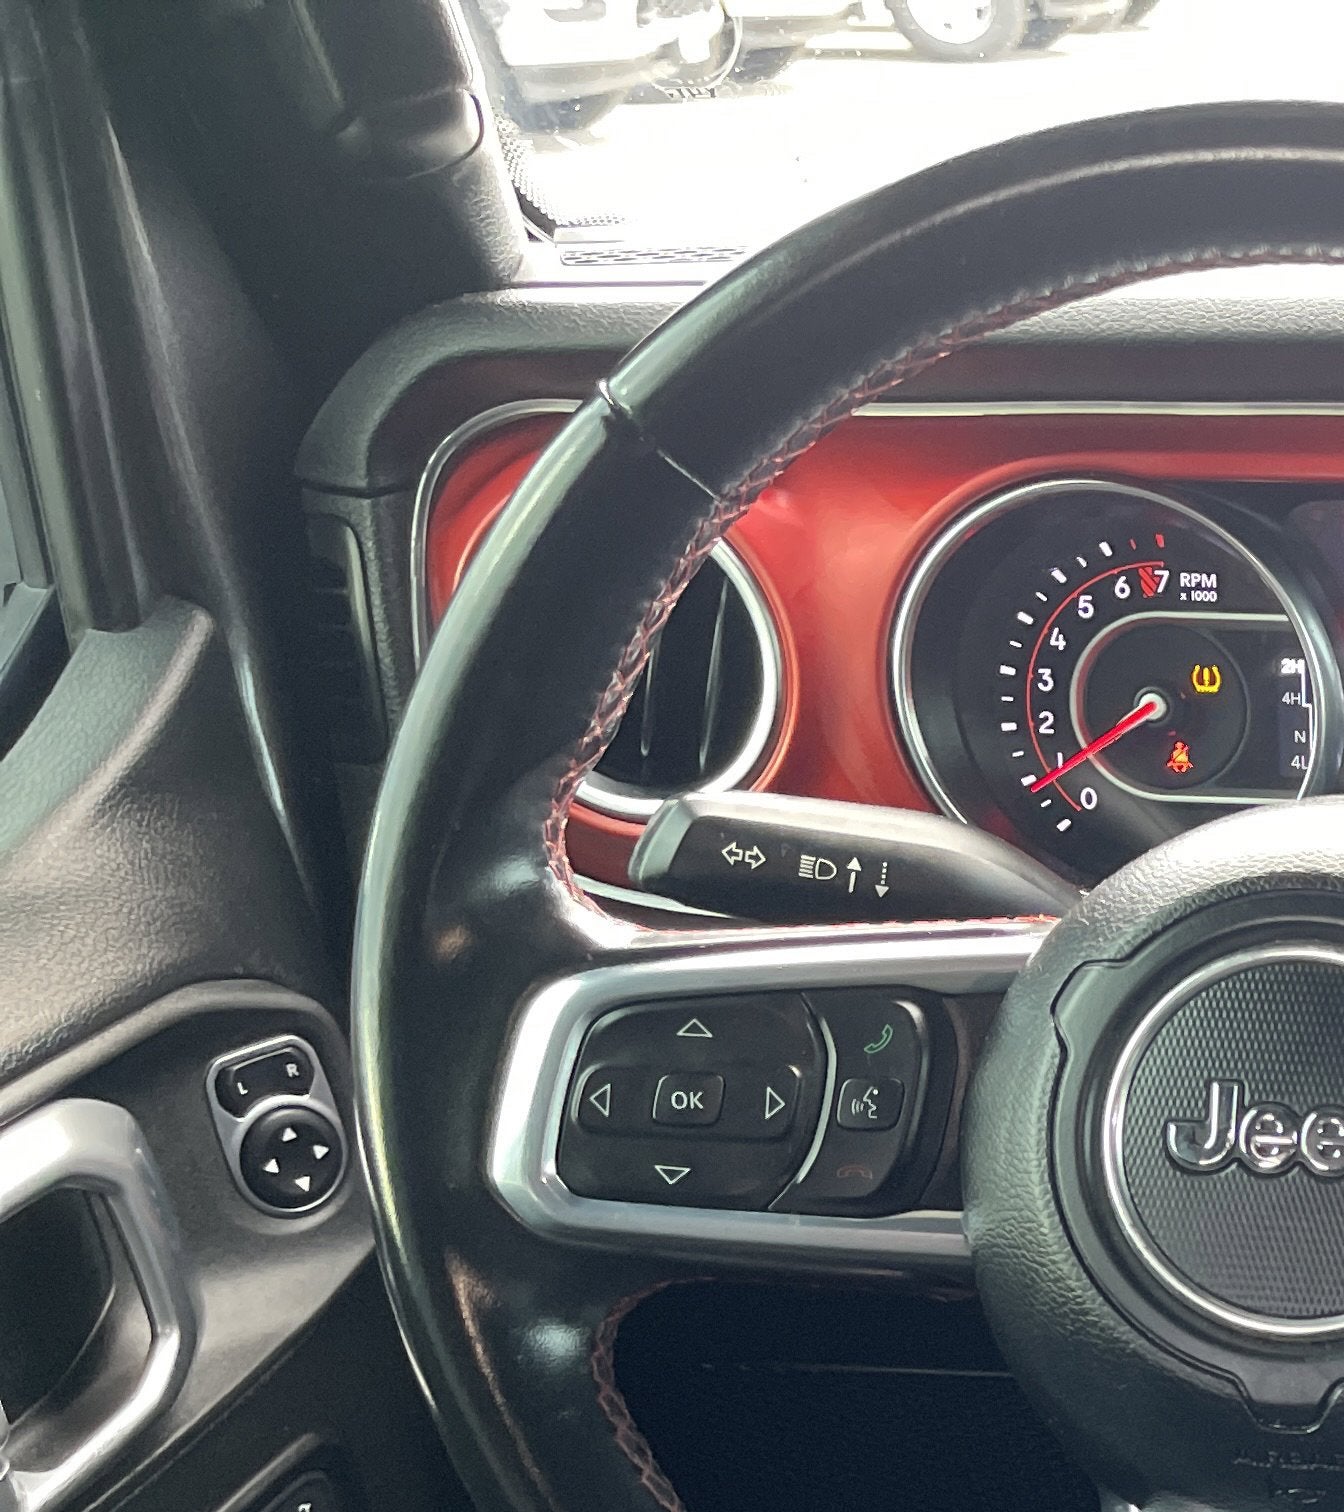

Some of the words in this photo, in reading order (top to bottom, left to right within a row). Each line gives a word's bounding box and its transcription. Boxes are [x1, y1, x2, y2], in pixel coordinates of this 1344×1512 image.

[1115, 576, 1130, 598] 6
[1154, 570, 1169, 593] 7
[1180, 573, 1217, 588] RPM
[1078, 595, 1094, 618] 5
[1191, 591, 1218, 602] 1000
[1050, 627, 1066, 650] 4
[1038, 668, 1054, 691] 3
[1282, 692, 1301, 705] 4H
[1038, 711, 1055, 734] 2
[1294, 730, 1306, 743] N
[1080, 787, 1098, 810] 0
[286, 1063, 300, 1078] R
[237, 1082, 248, 1095] L
[671, 1091, 704, 1109] OK
